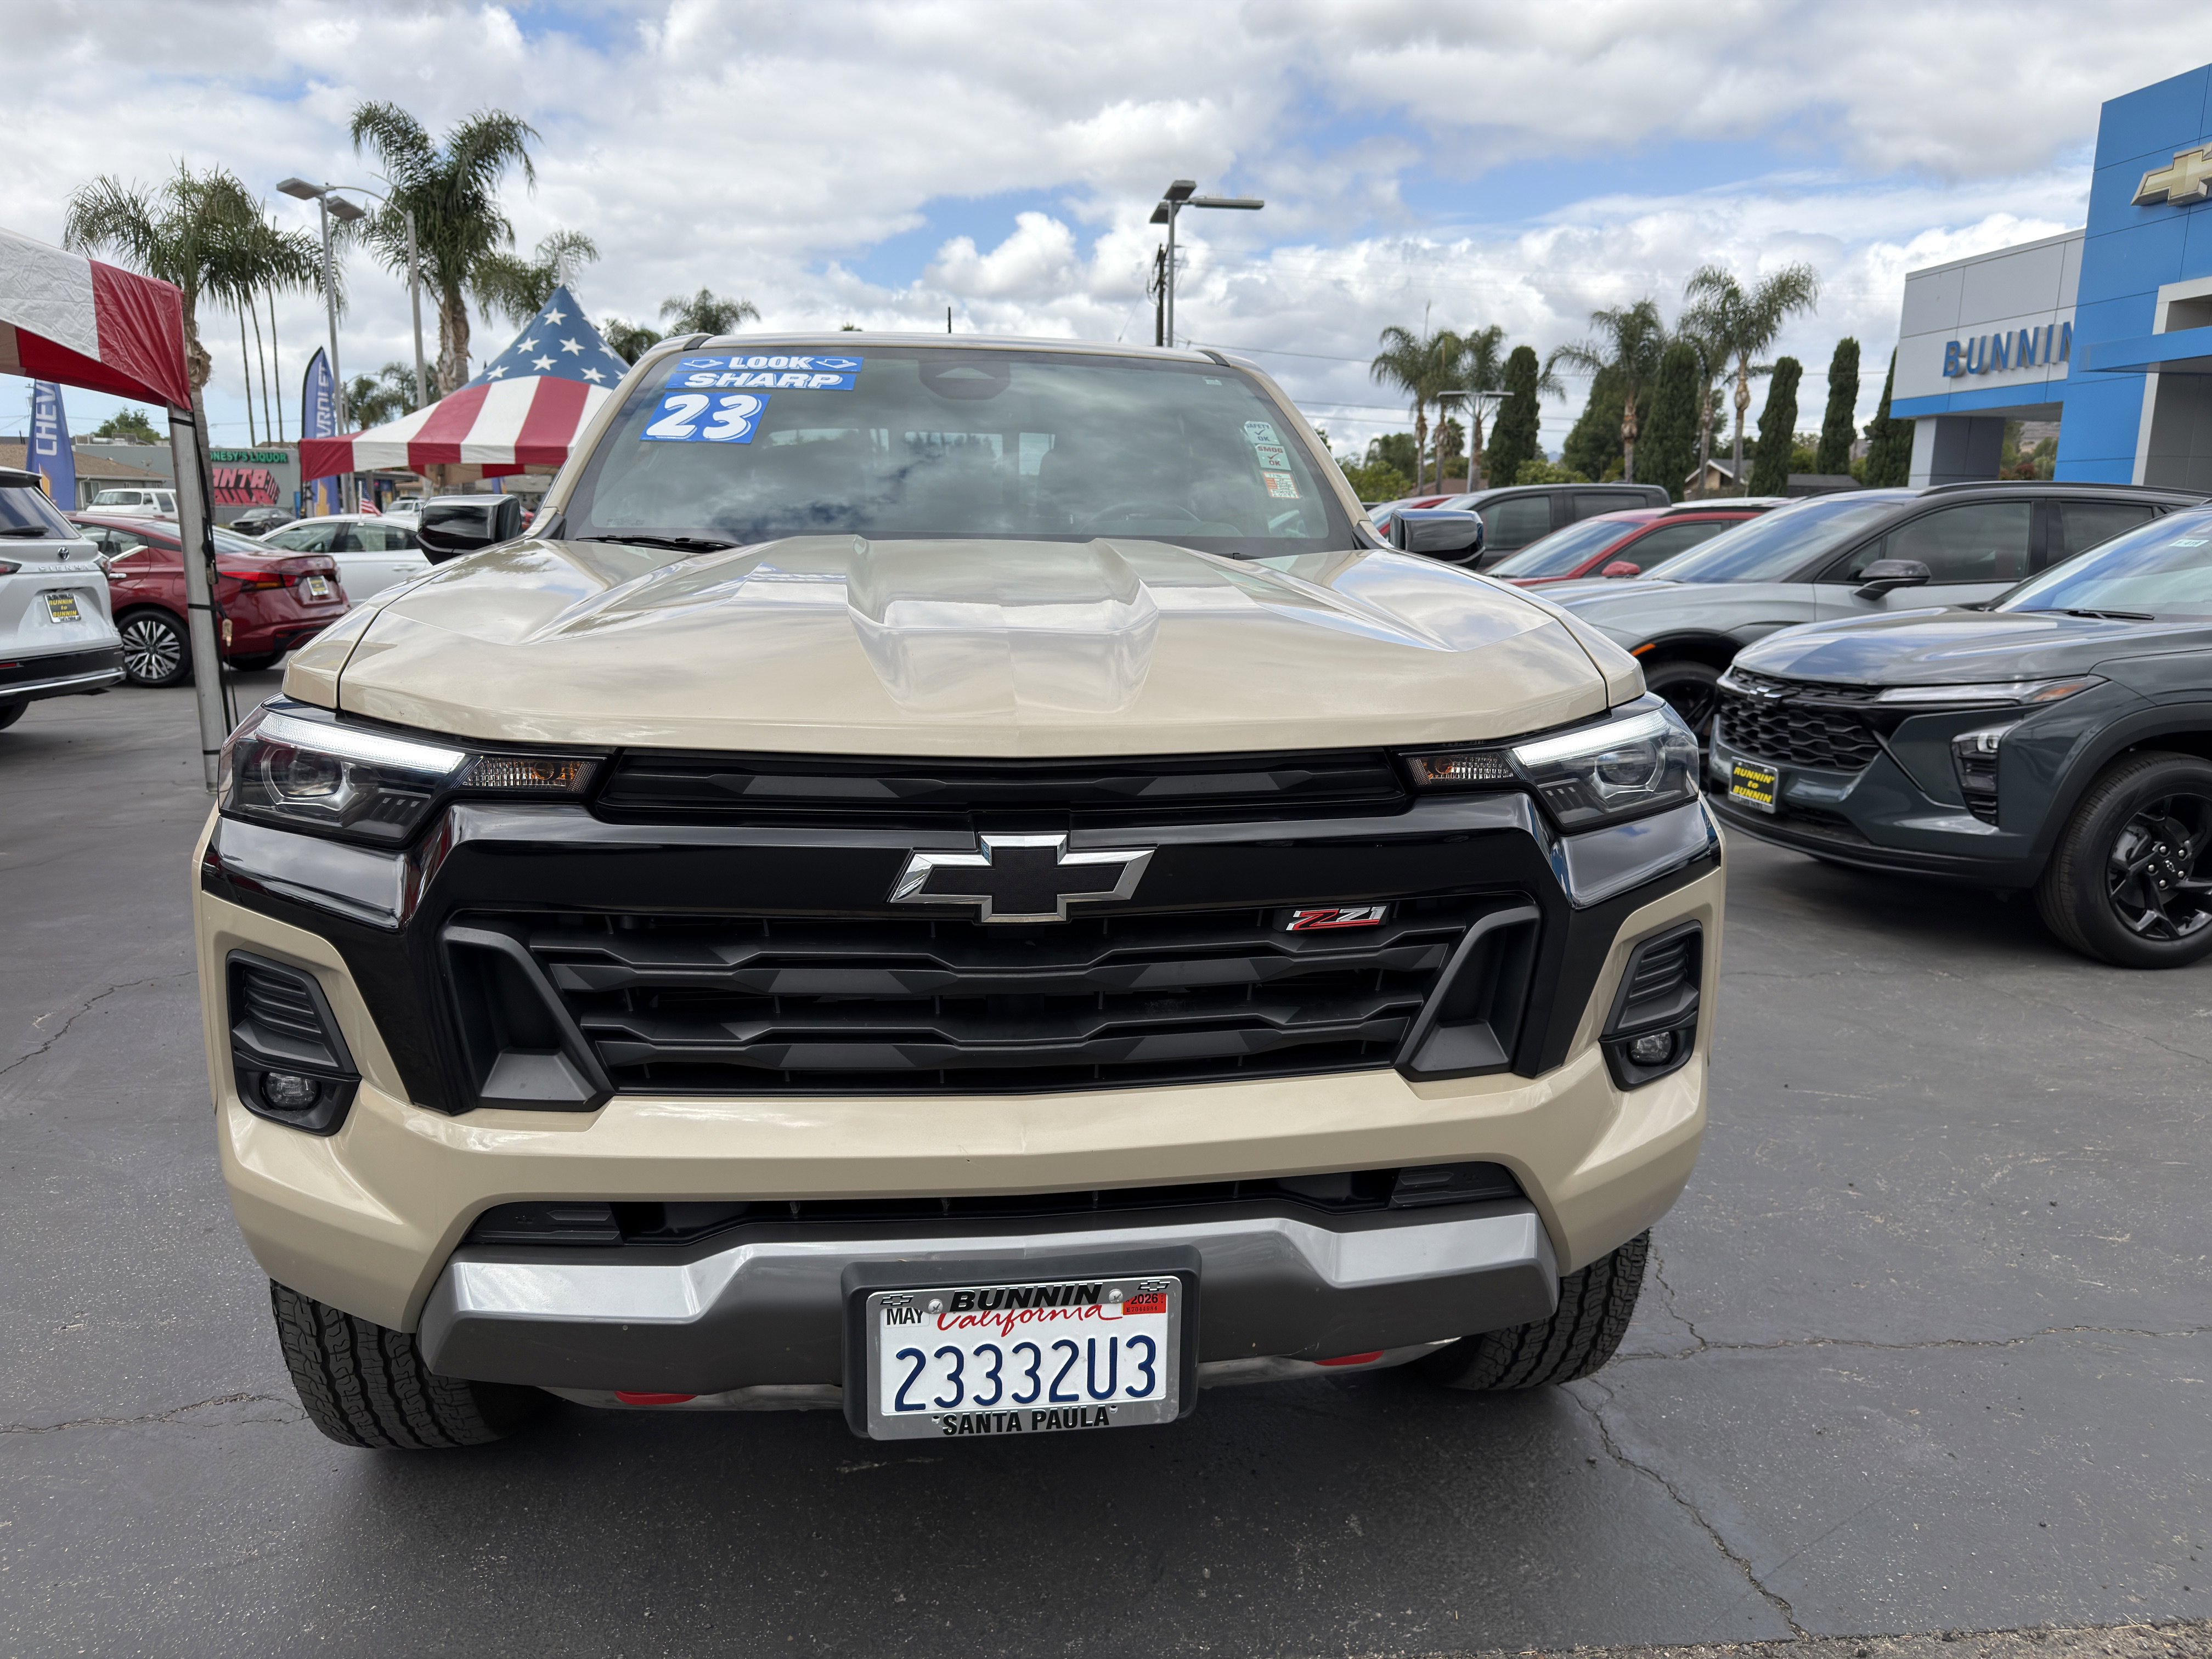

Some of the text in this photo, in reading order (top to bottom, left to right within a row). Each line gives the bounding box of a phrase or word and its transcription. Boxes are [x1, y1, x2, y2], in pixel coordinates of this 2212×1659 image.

[1943, 321, 2073, 377] BUNNIN
[729, 356, 816, 370] LOOK
[684, 373, 843, 389] SHARP
[646, 394, 762, 441] 23
[250, 452, 287, 463] LIQUOR
[1734, 766, 1775, 784] RUNNIN'
[1747, 780, 1759, 789] to
[1733, 785, 1772, 803] BUNNIN
[950, 1282, 1103, 1312] BUNNIN
[1131, 1293, 1158, 1305] 2026
[887, 1307, 923, 1325] MAY
[937, 1304, 1123, 1338] California
[894, 1334, 1156, 1412] 23332U3
[943, 1404, 1110, 1436] SANTA PAULA
